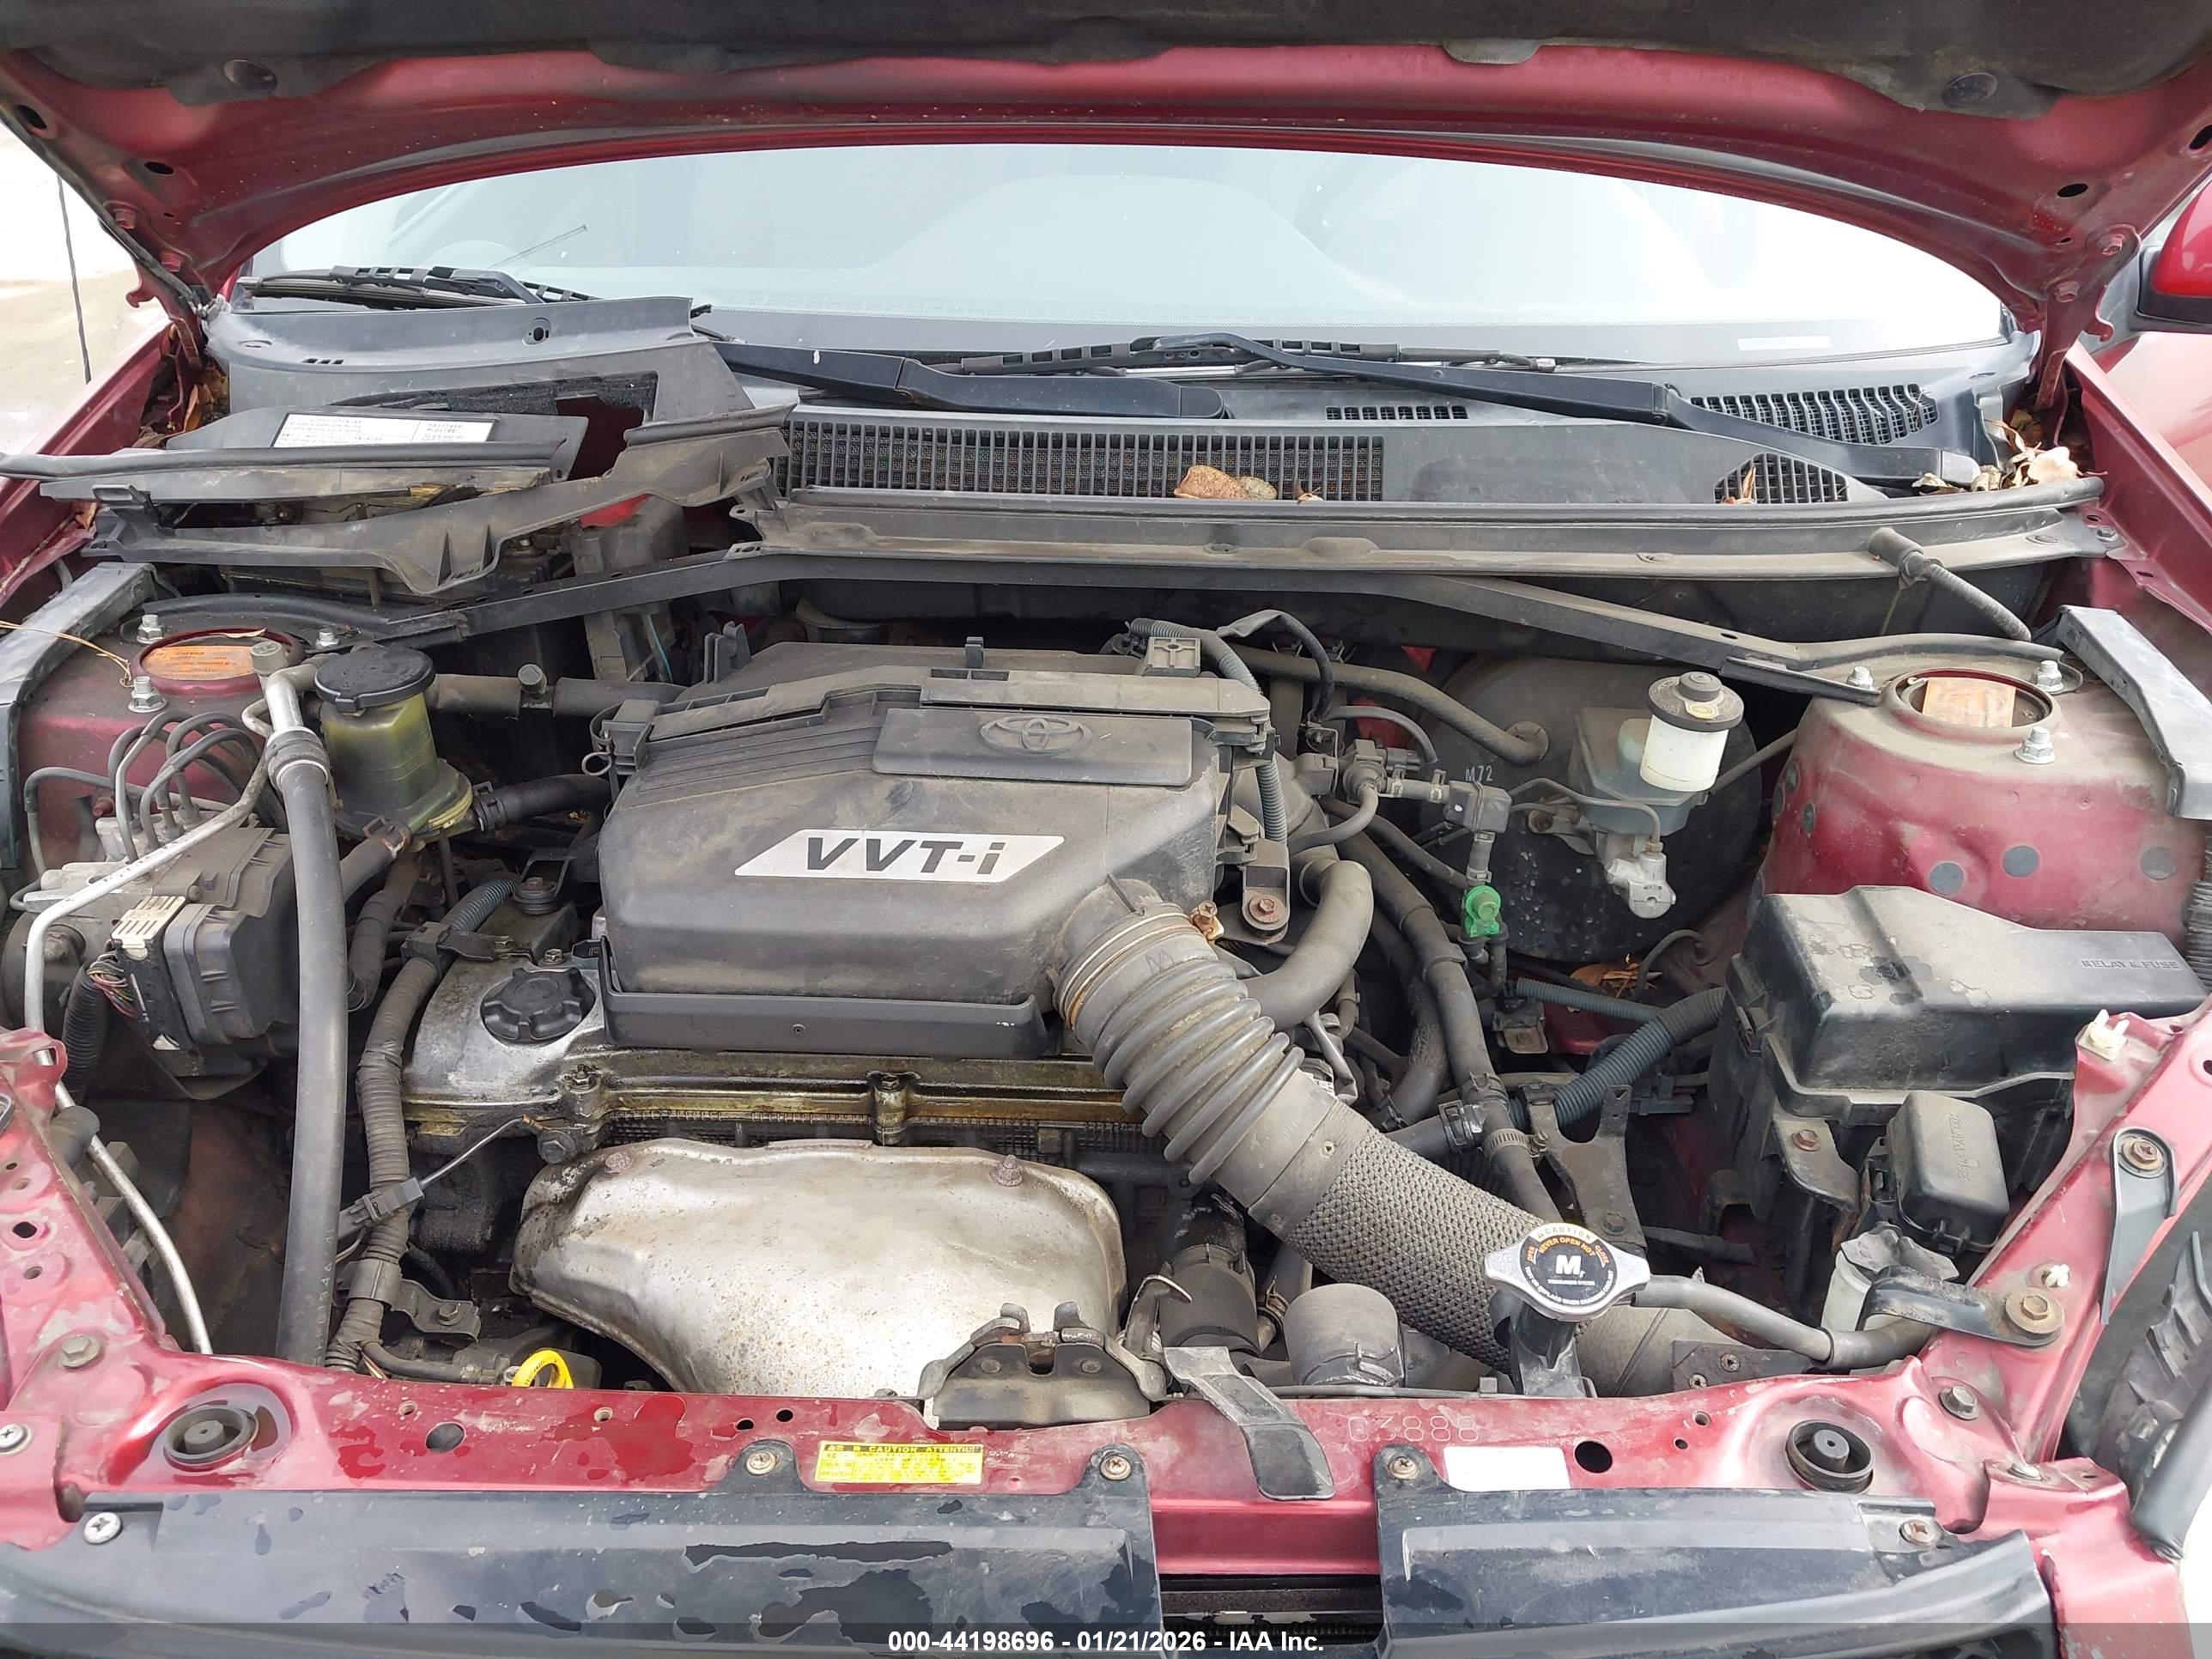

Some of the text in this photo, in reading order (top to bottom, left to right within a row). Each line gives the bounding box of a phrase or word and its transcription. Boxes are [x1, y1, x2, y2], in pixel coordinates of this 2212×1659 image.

[1465, 765, 1493, 782] M72
[807, 836, 1006, 875] VVT-i
[2081, 959, 2181, 969] RELAY & FUSE
[1545, 1225, 1591, 1241] CAUTION
[1538, 1237, 1560, 1254] NEVER
[1559, 1236, 1582, 1247] OPEN
[1526, 1246, 1535, 1262] OPEN
[1595, 1244, 1610, 1264] CLOSE
